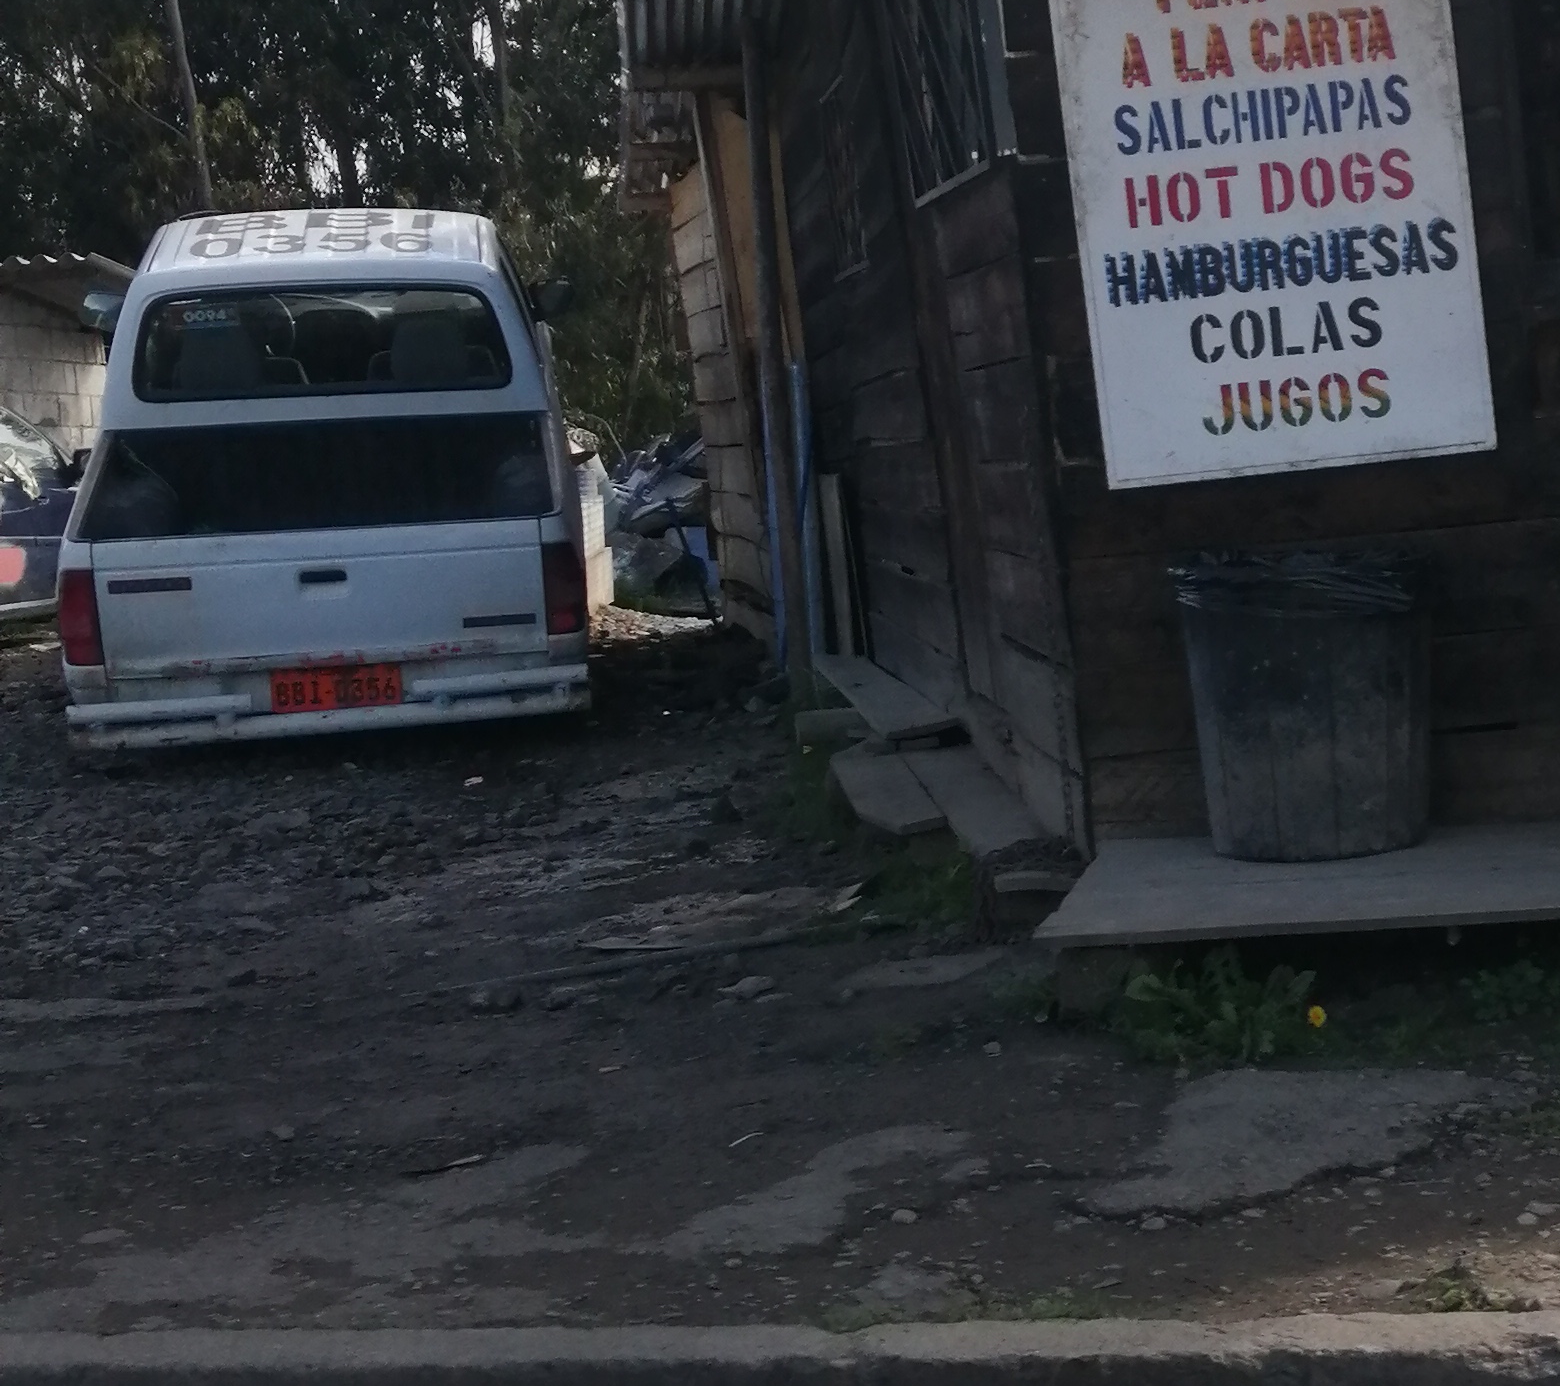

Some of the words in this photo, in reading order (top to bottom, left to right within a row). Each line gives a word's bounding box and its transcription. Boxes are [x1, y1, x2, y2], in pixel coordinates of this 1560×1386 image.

[1122, 33, 1150, 88] A
[1170, 24, 1234, 83] LA
[1250, 5, 1397, 73] CARTA
[1114, 74, 1412, 156] SALCHIPAPAS
[1125, 165, 1238, 228] HOT
[1259, 148, 1415, 215] DOGS
[190, 231, 432, 259] 0356
[1105, 217, 1458, 308] HAMBURGUESAS
[1190, 296, 1383, 365] COLAS
[1202, 368, 1391, 436] JUGOS
